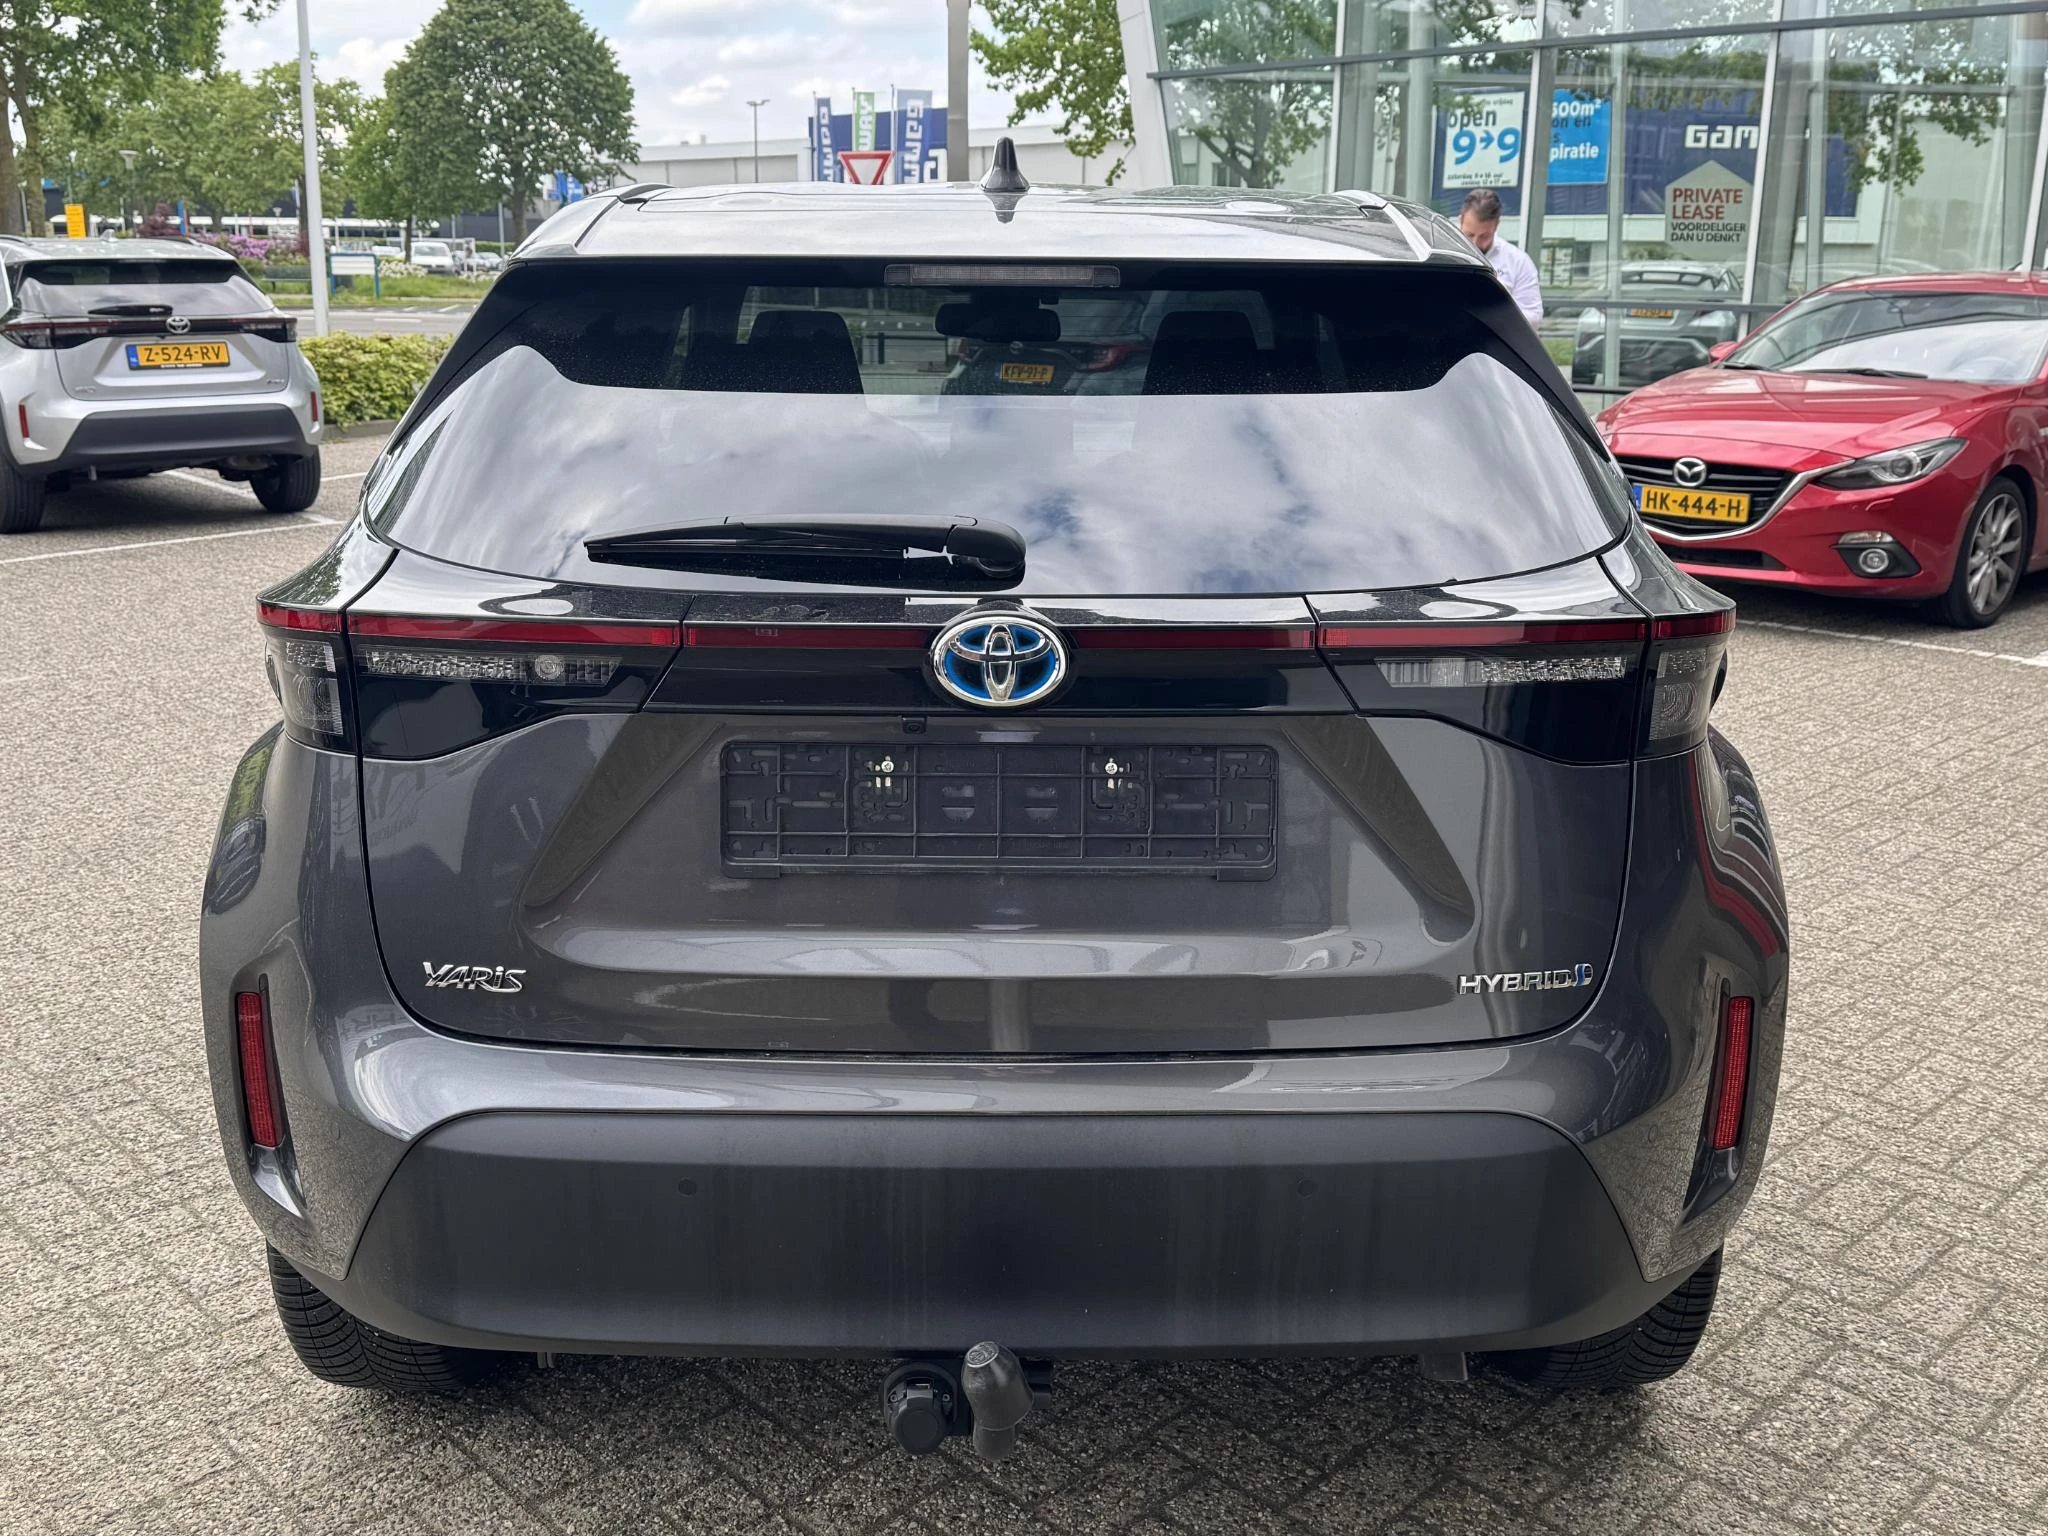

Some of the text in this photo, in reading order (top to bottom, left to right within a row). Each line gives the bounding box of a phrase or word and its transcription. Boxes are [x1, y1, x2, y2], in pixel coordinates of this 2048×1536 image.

[1448, 108, 1497, 131] open
[1672, 188, 1743, 204] PRIVATE
[1672, 204, 1725, 220] LEASE
[1671, 221, 1746, 232] VOORDELIGER
[1671, 232, 1742, 242] DAN U DENKT
[144, 345, 222, 362] Z-524-RV
[1645, 488, 1742, 518] HK-444-H
[1458, 969, 1574, 995] HYBRID
